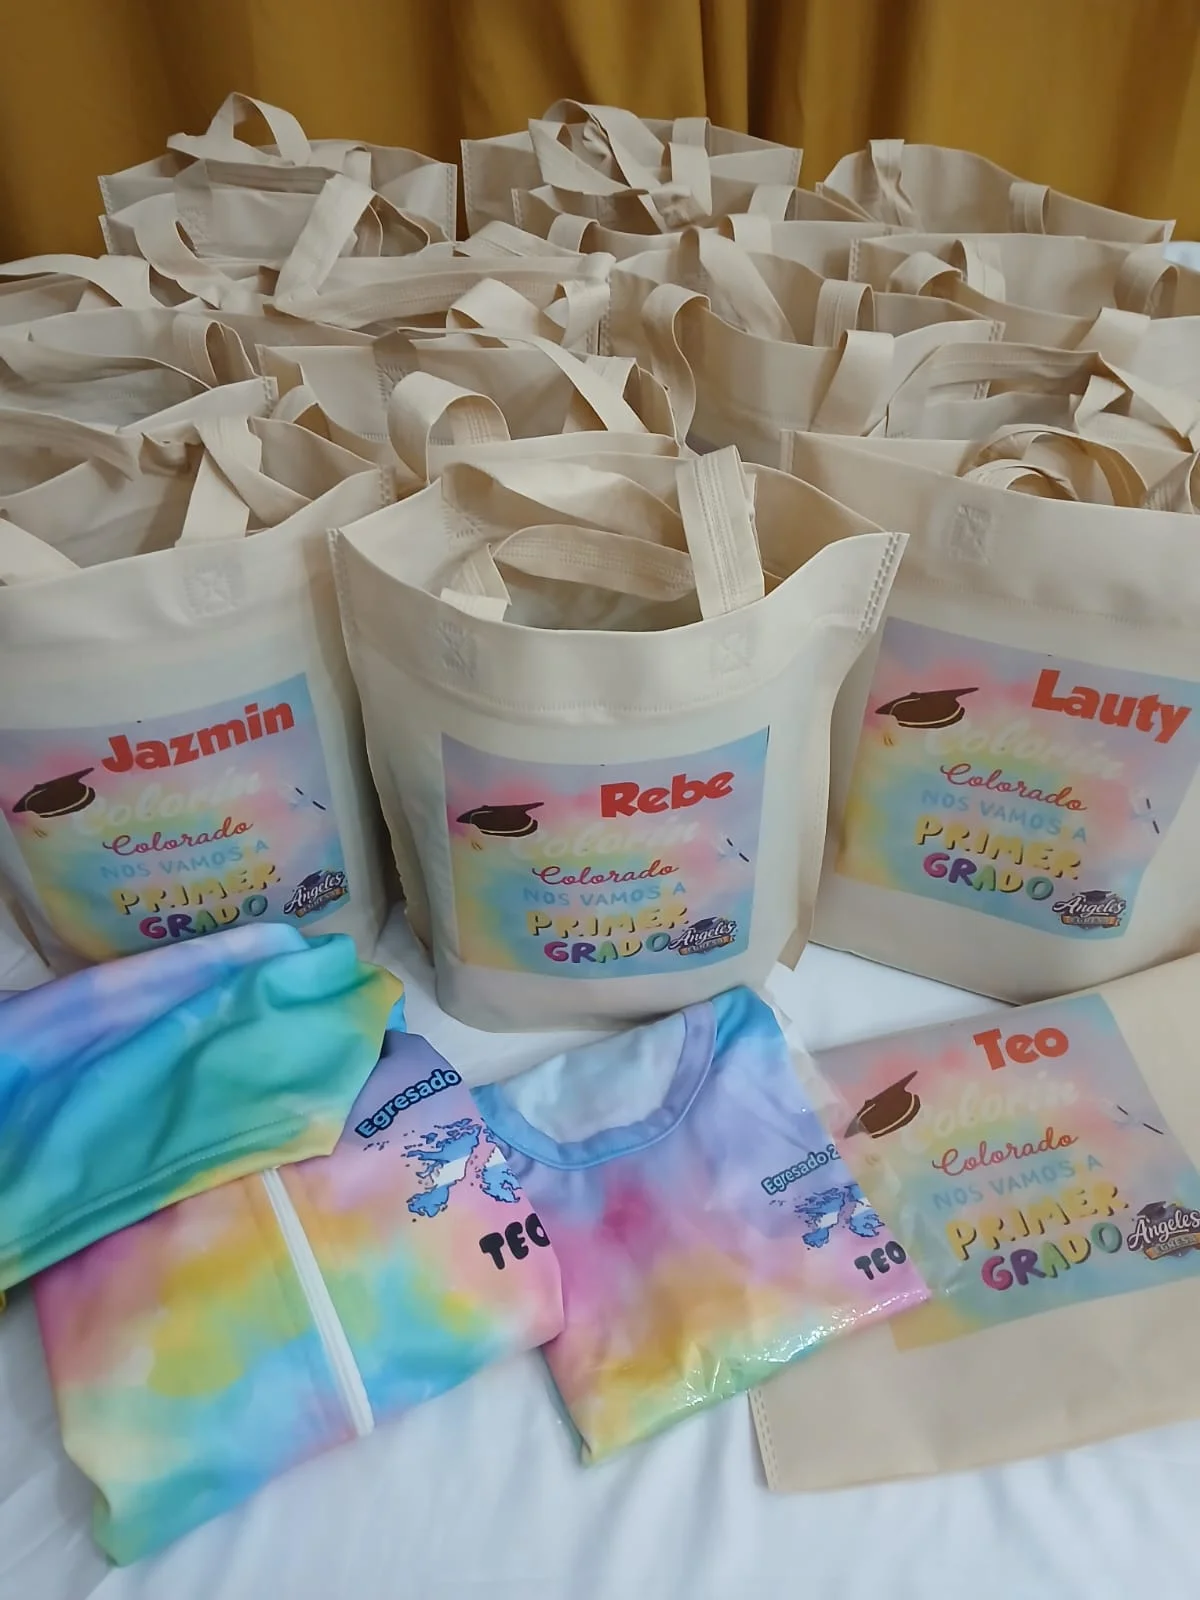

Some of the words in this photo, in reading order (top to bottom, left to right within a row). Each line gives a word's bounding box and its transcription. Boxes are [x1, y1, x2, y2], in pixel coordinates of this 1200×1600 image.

[1032, 669, 1192, 744] Lauty
[101, 703, 295, 773] Jazmin
[600, 771, 734, 818] Rebe
[940, 762, 1087, 811] Colorado
[102, 817, 254, 856] Colorado
[921, 789, 970, 812] NOS
[980, 800, 1063, 837] VAMOS
[1072, 824, 1087, 843] A
[101, 864, 151, 881] NOS
[161, 846, 243, 875] VAMOS
[255, 839, 270, 854] A
[915, 815, 1081, 880] PRIMER
[111, 865, 281, 915] PRIMER
[523, 887, 570, 905] NOS
[580, 885, 661, 907] VAMOS
[672, 881, 687, 895] A
[531, 859, 680, 885] Colorado
[923, 853, 1054, 901] GRADO
[139, 894, 269, 939] GRADO
[525, 906, 689, 939] PRIMER
[543, 932, 671, 963] GRADO
[973, 1027, 1069, 1071] Teo
[355, 1069, 462, 1138] Egresado
[761, 1152, 829, 1196] Egresado
[932, 1127, 1079, 1176] Colorado
[932, 1184, 984, 1210] NOS
[993, 1160, 1076, 1195] VAMOS
[1087, 1154, 1103, 1170] A
[945, 1181, 1129, 1261] PRIMER
[854, 1240, 906, 1280] TEO
[981, 1222, 1123, 1290] GRADO
